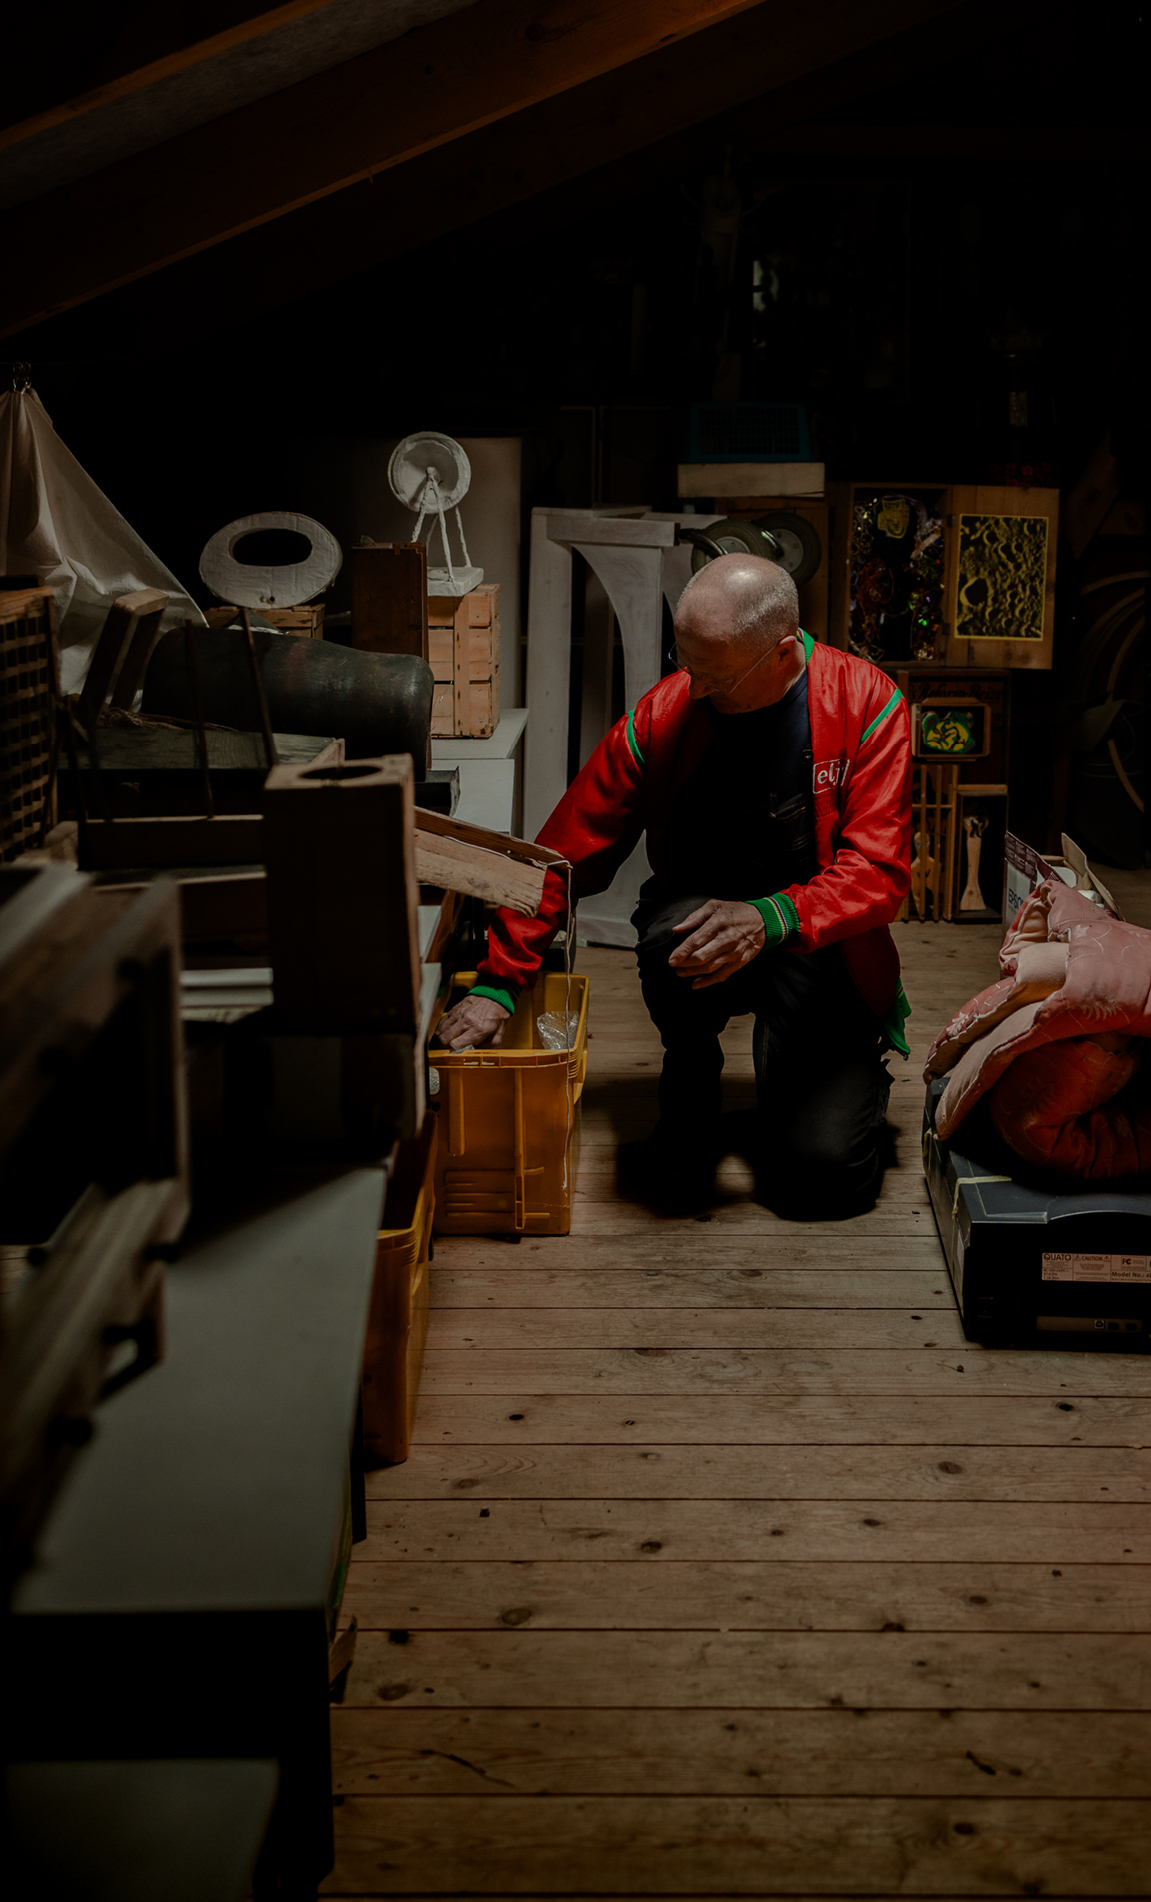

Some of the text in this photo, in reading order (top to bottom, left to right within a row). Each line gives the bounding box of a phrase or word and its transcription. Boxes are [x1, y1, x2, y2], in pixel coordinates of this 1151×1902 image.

[816, 761, 844, 786] elj
[1008, 888, 1024, 910] EPSO
[1043, 1253, 1072, 1261] QUATO
